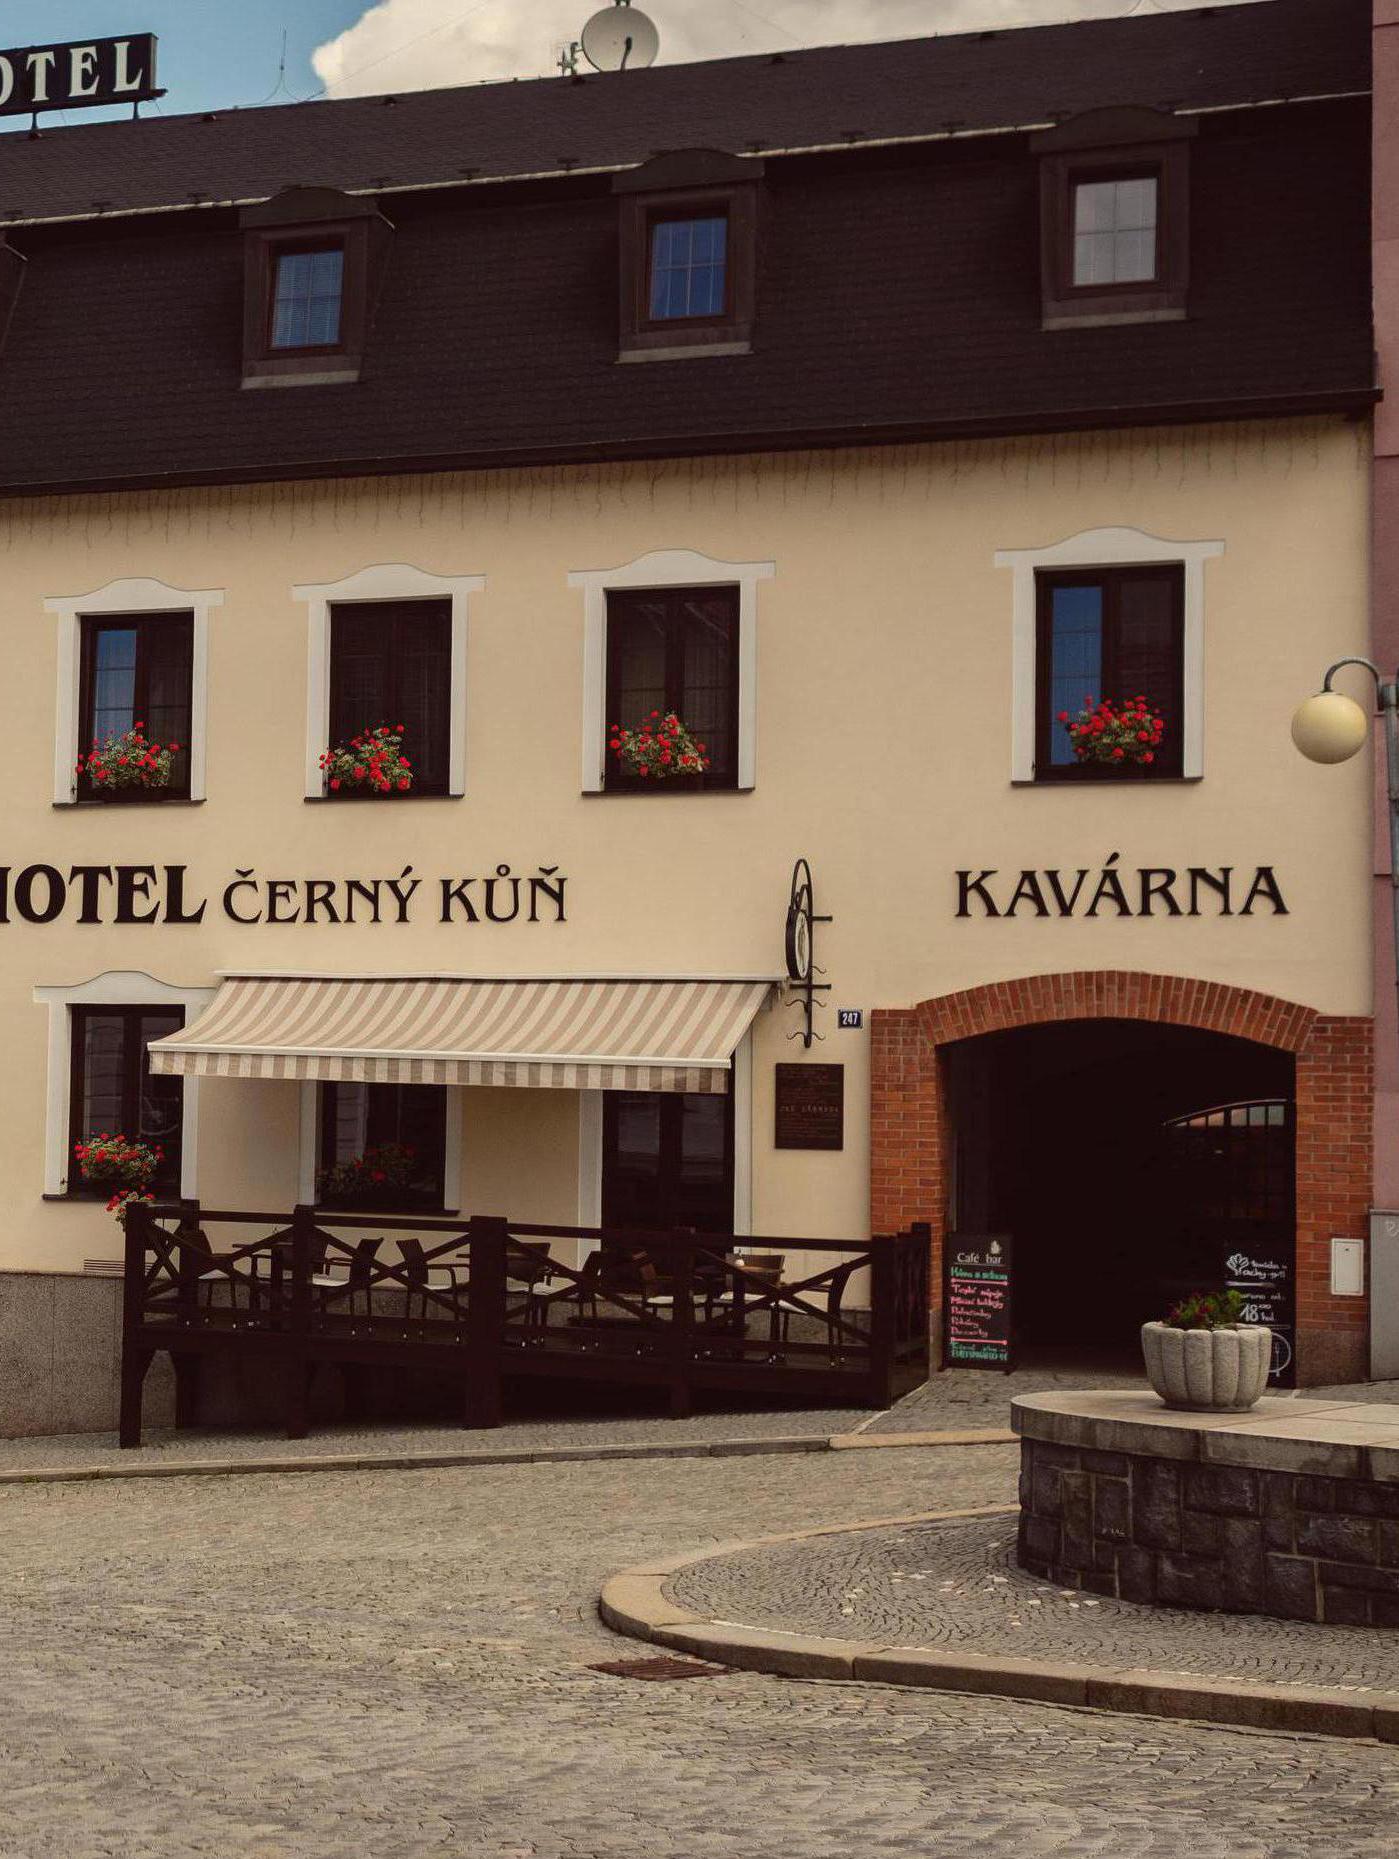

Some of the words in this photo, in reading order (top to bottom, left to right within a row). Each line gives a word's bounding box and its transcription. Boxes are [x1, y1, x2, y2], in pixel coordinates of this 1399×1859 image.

[222, 864, 422, 925] ČERNÝ
[438, 863, 569, 924] KŮŇ
[955, 852, 1291, 918] KAVÁRNA
[842, 1012, 858, 1025] 247
